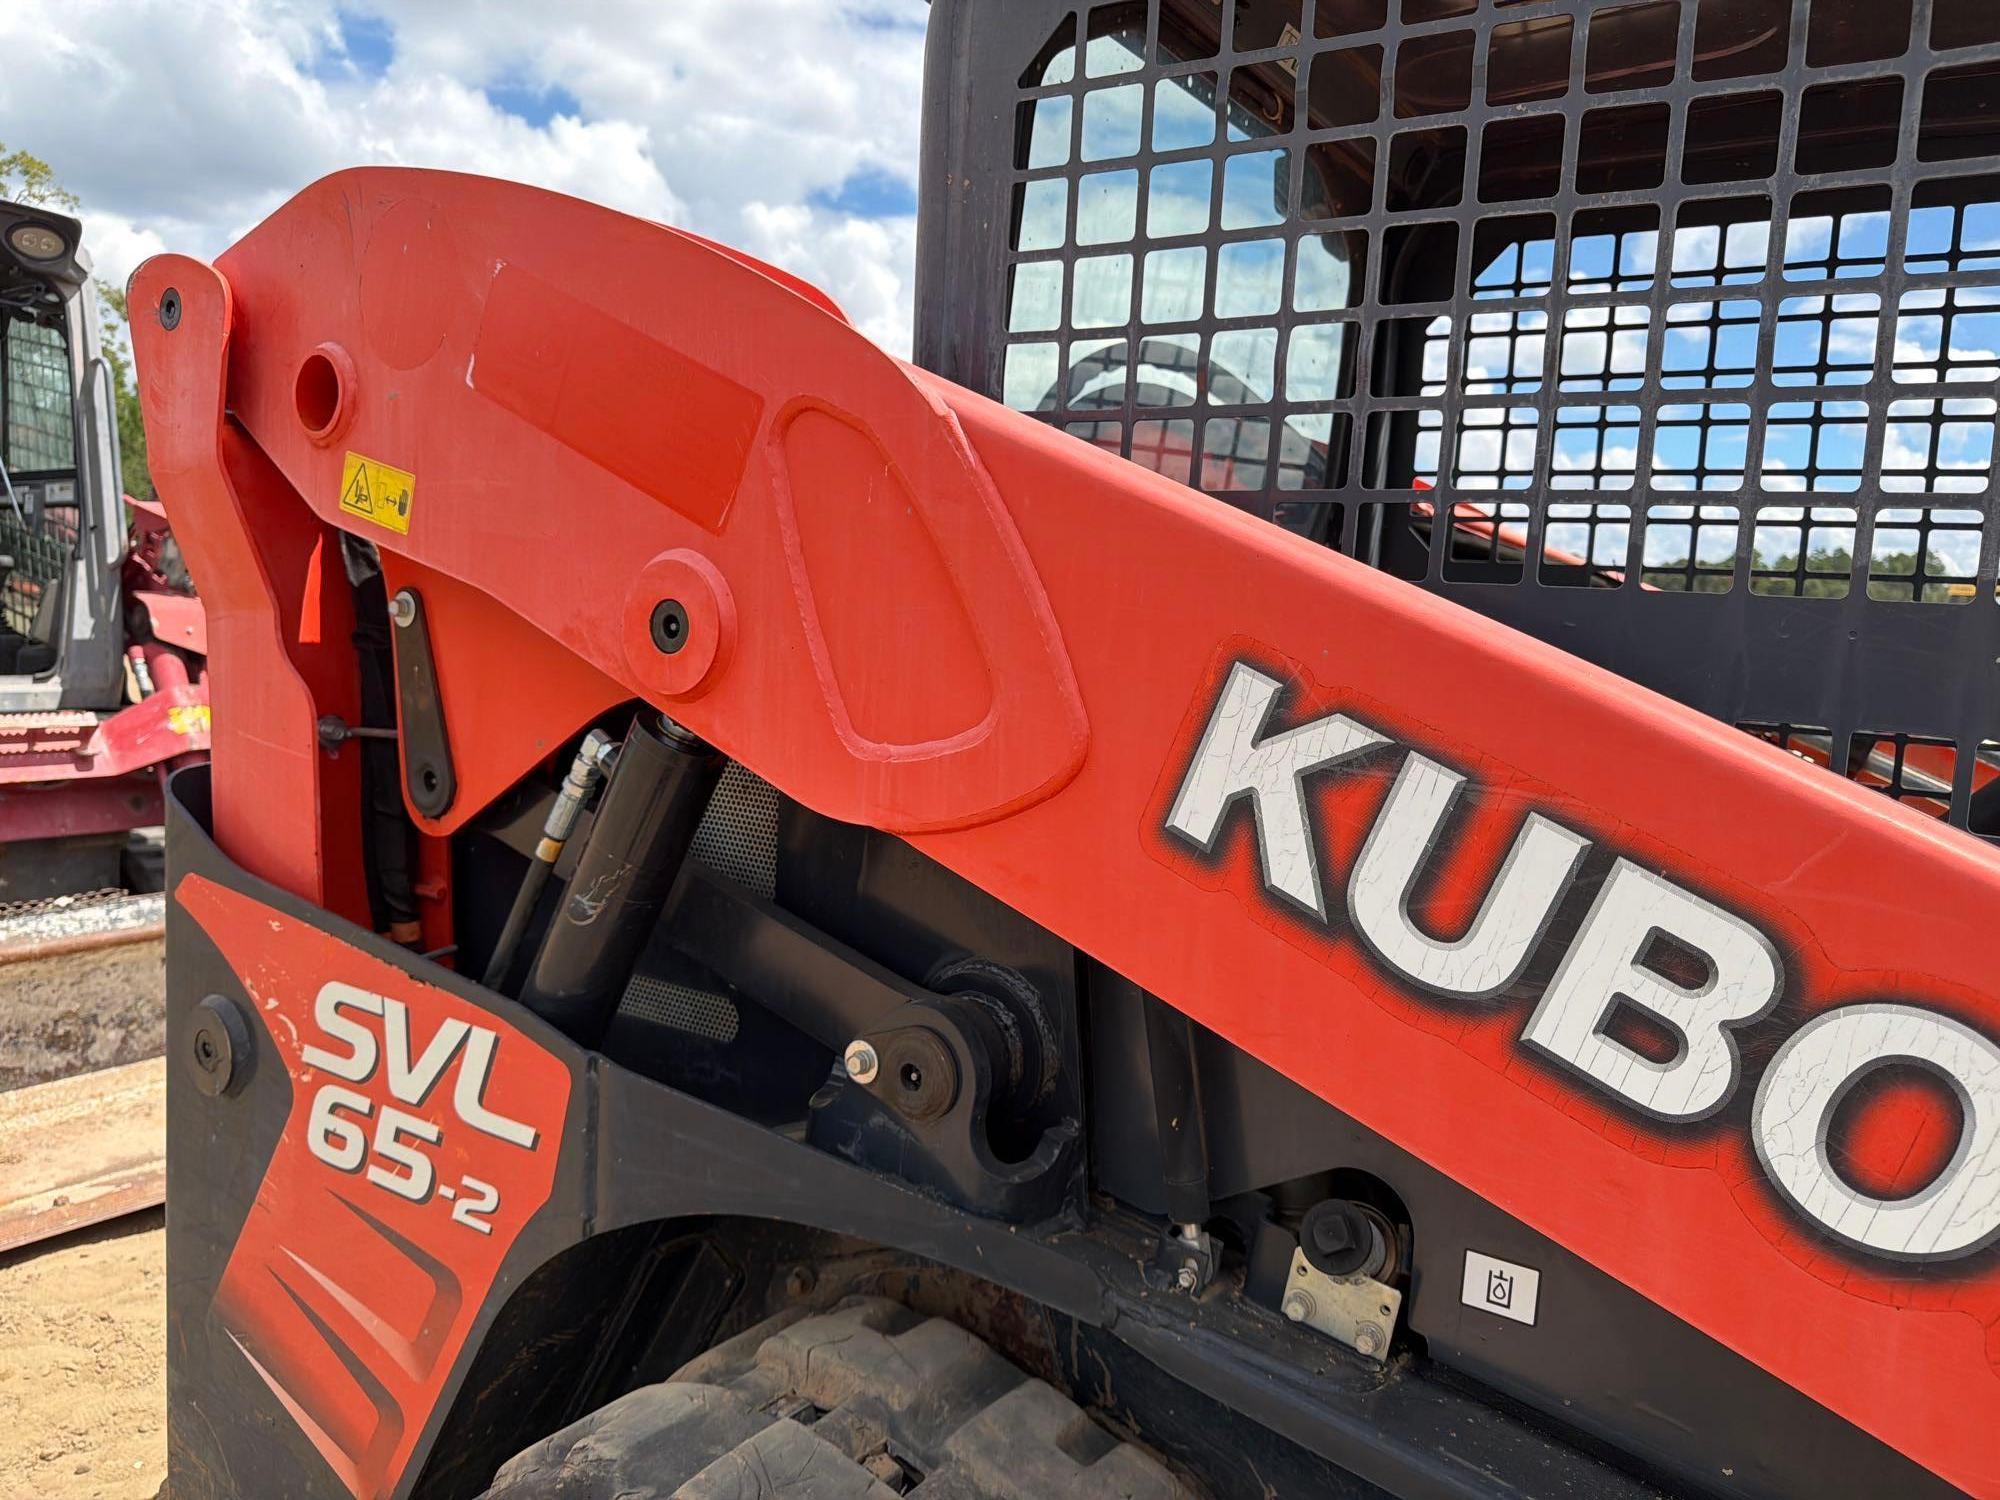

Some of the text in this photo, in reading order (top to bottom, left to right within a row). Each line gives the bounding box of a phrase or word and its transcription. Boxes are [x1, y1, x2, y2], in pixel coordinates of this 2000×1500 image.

[1165, 661, 2000, 1263] KUBO
[302, 980, 538, 1149] SVL
[307, 1084, 499, 1234] 65-2
